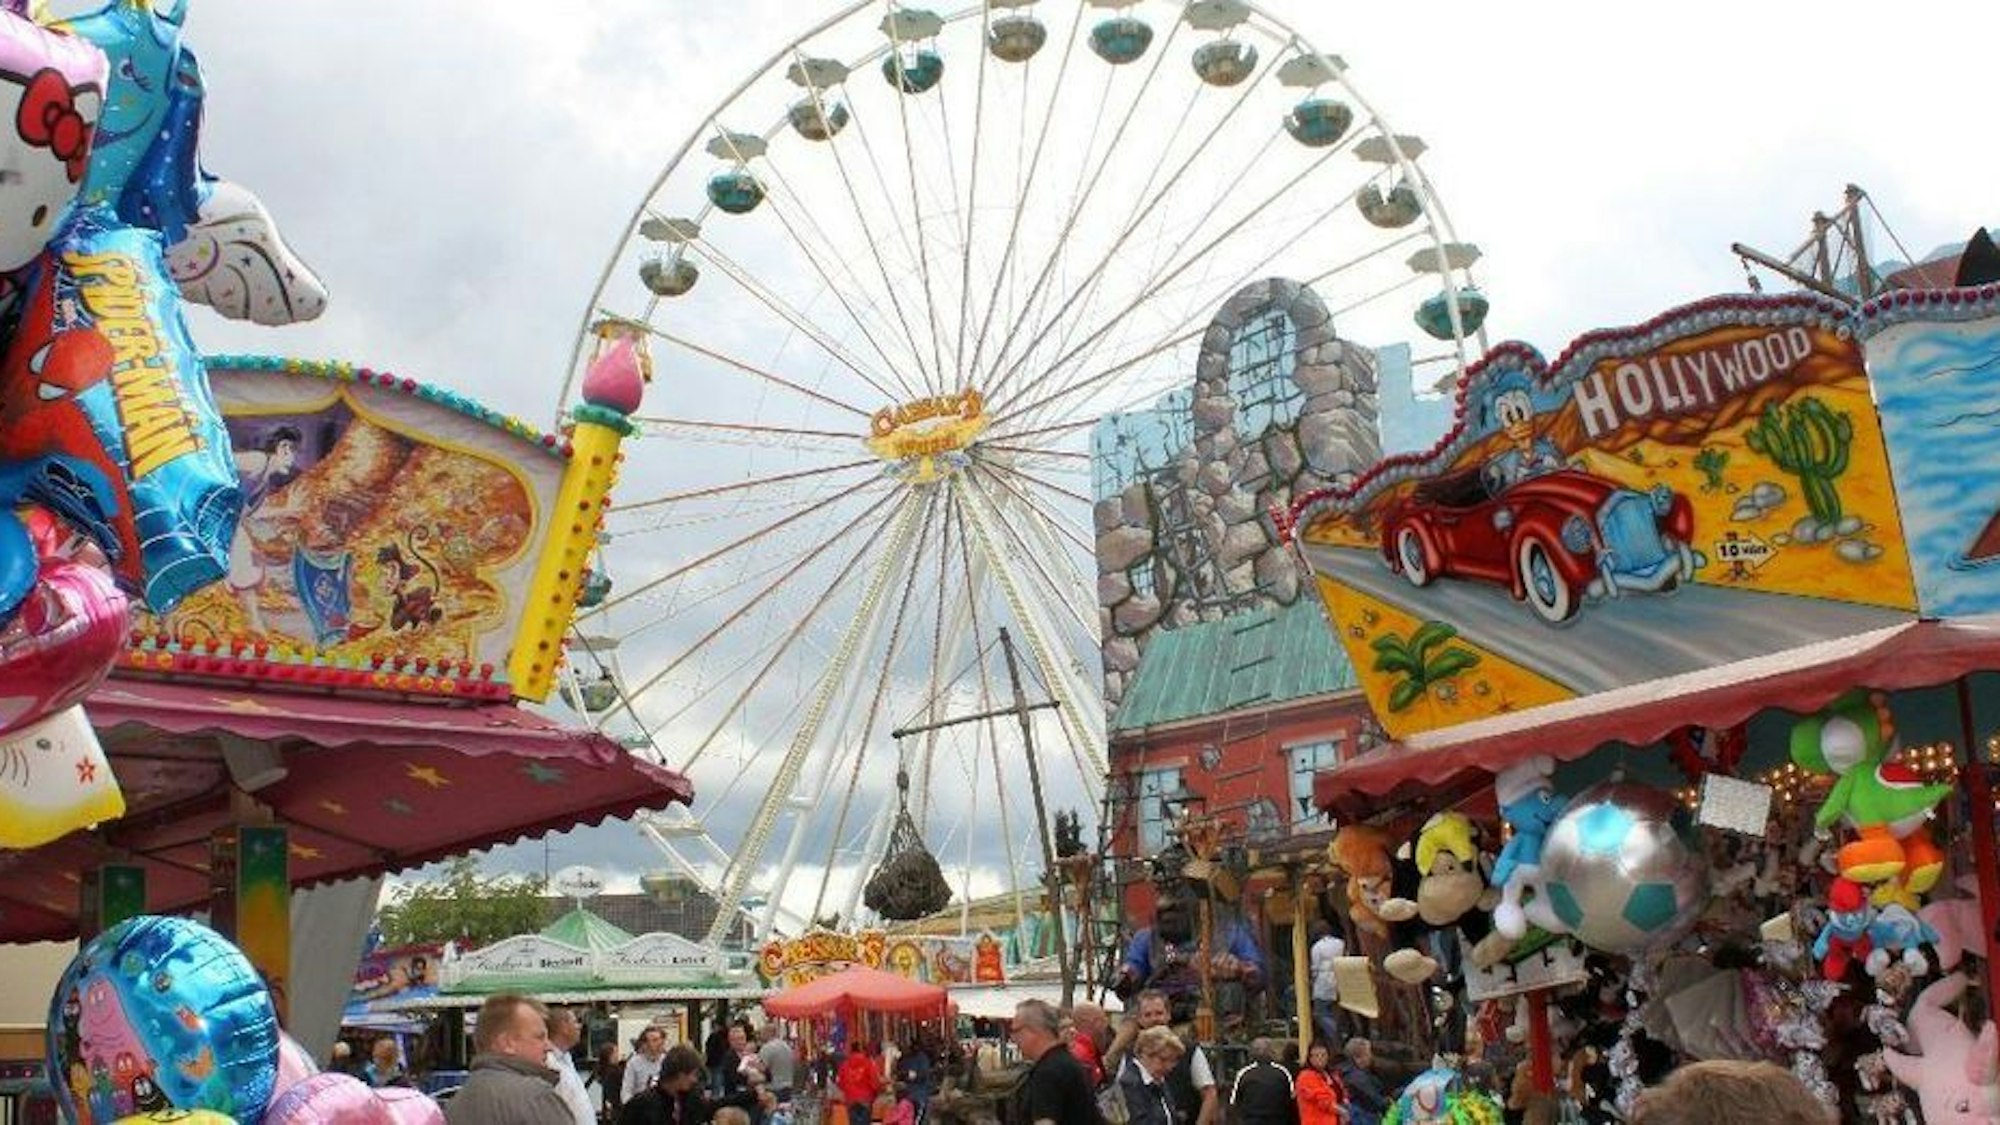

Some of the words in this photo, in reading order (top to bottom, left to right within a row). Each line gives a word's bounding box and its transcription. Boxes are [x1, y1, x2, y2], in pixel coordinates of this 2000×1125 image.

[64, 252, 199, 478] SPIDER-MAN
[1573, 327, 1811, 438] HOLLYWOOD
[1720, 544, 1739, 557] 10
